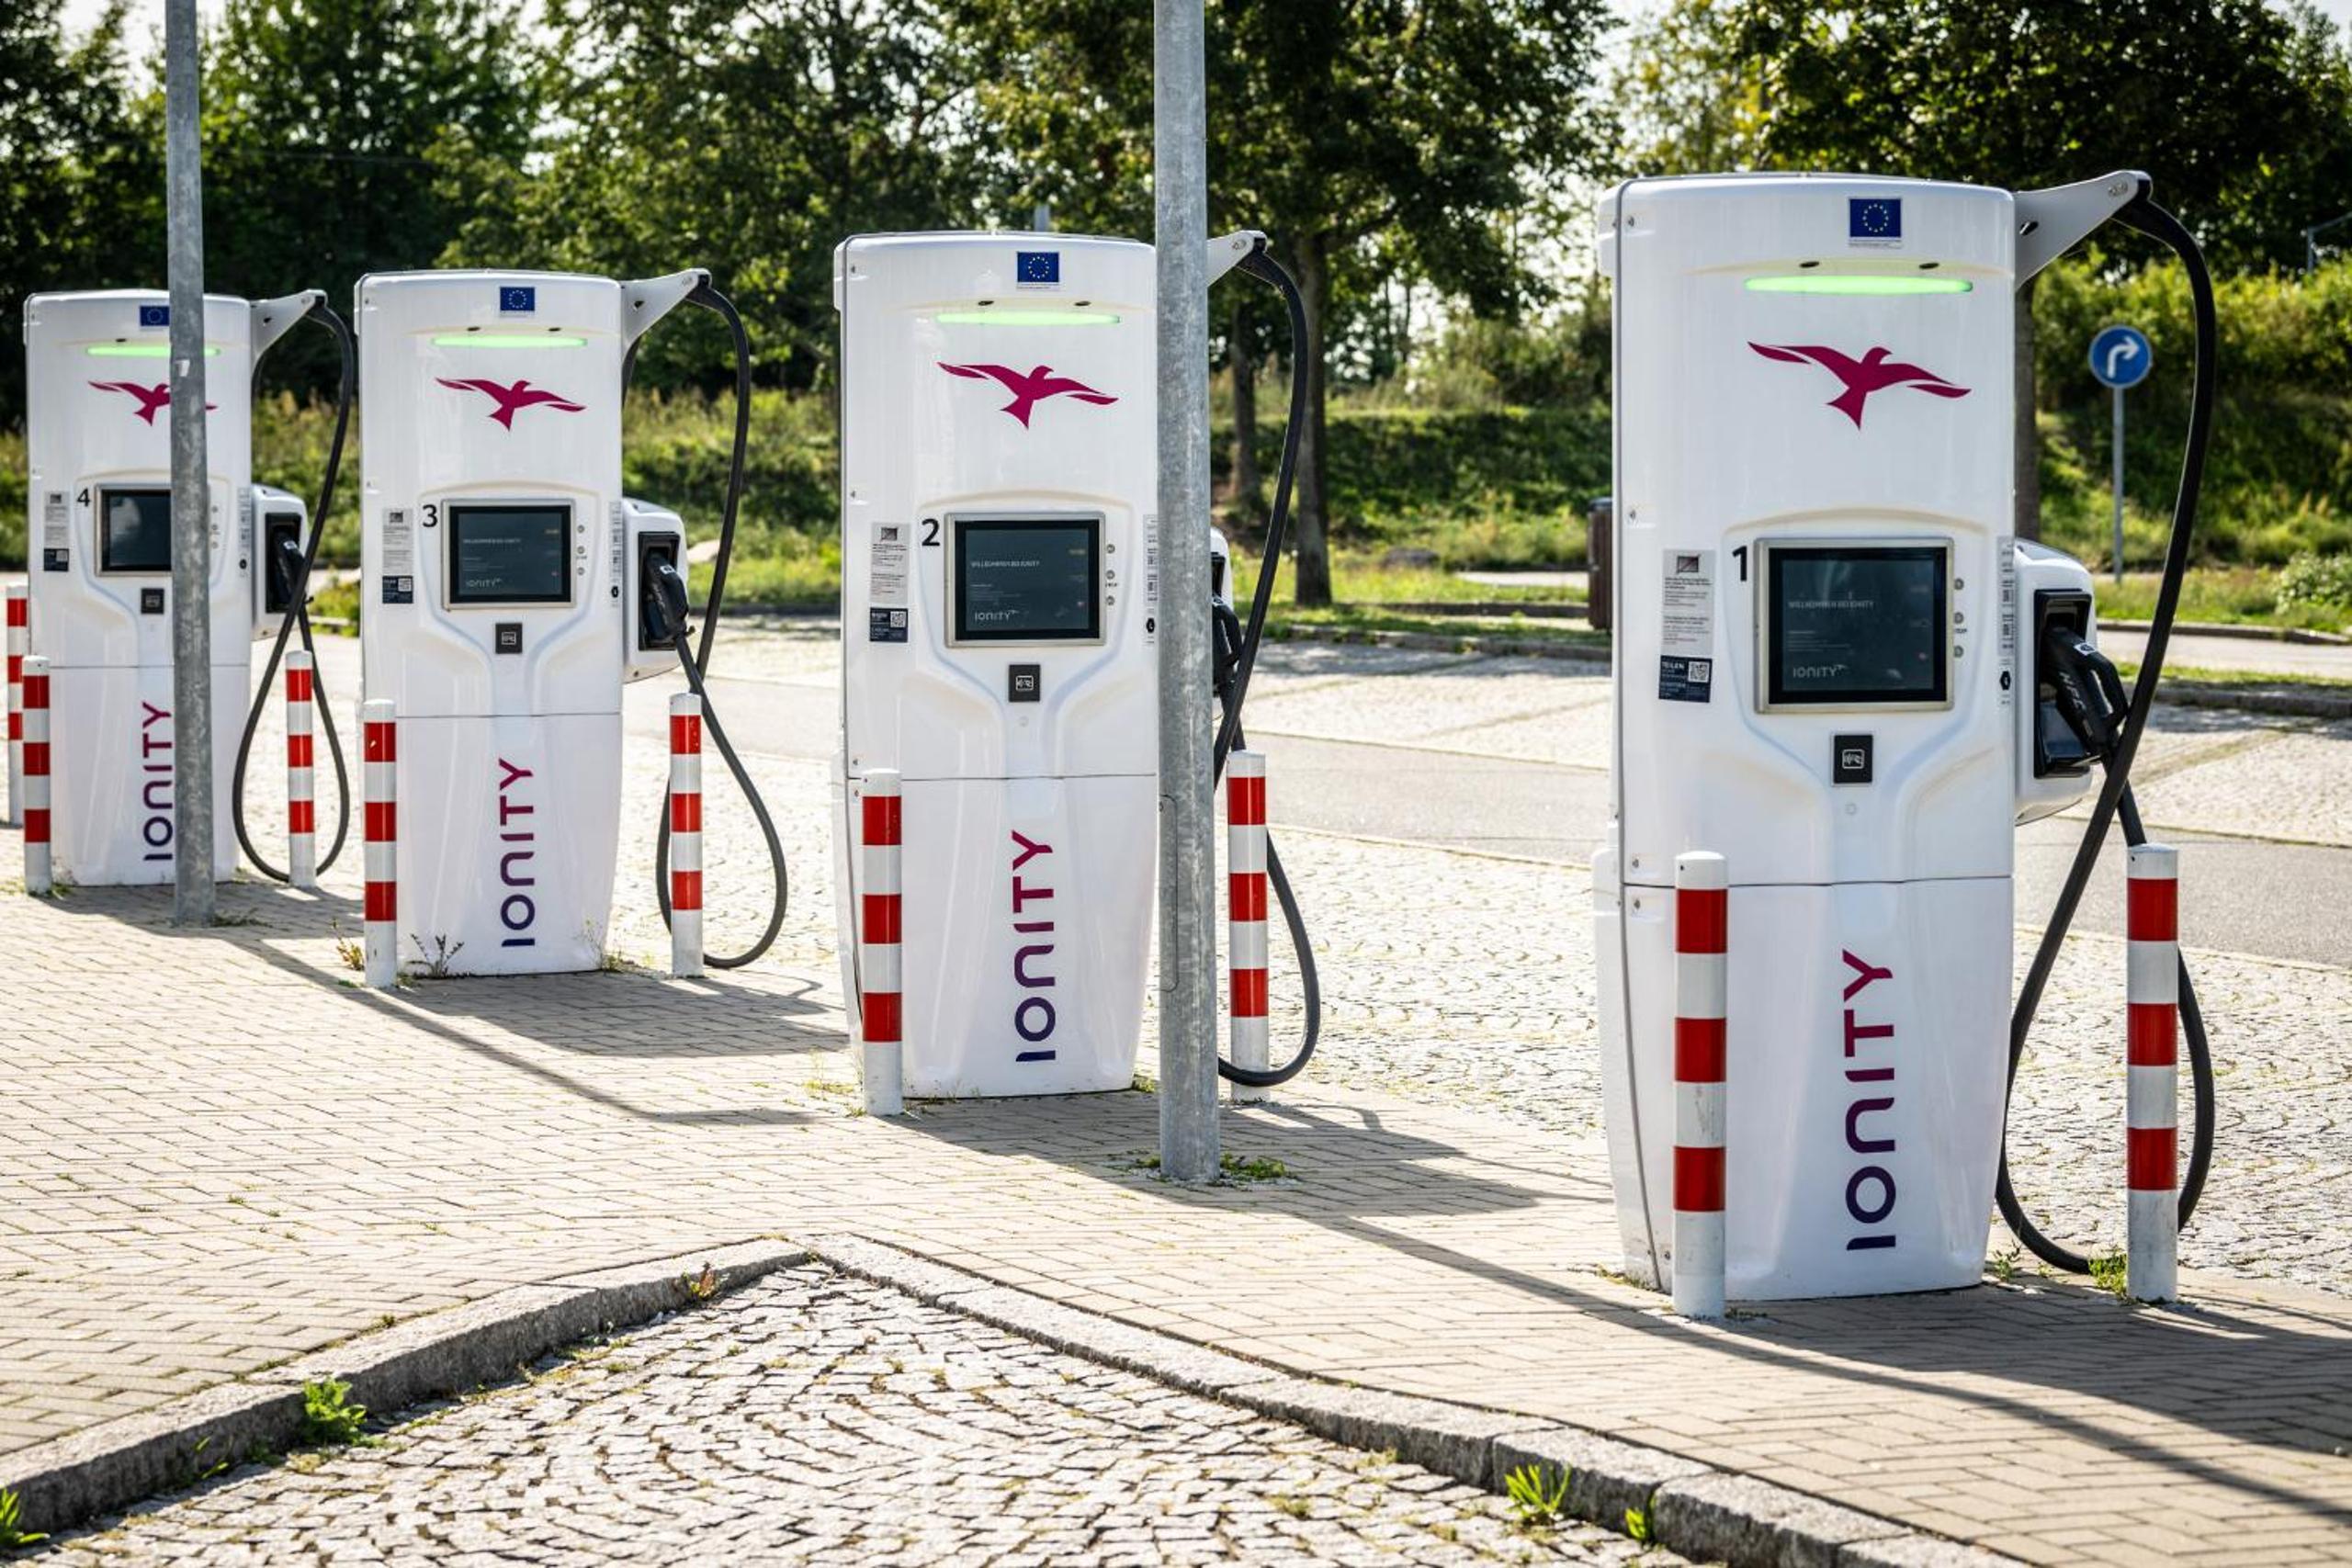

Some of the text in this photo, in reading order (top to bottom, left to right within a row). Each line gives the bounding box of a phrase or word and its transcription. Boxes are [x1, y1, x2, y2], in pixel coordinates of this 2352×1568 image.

[76, 488, 91, 507] 4
[423, 503, 438, 528] 3
[922, 518, 941, 547] 2
[1732, 546, 1747, 581] 1
[975, 611, 1011, 622] IONITY
[1792, 666, 1838, 678] IONITY
[142, 702, 173, 861] IONITY
[499, 758, 536, 947] IONITY
[1012, 829, 1057, 1062] IONITY
[1842, 949, 1896, 1250] IONITY
